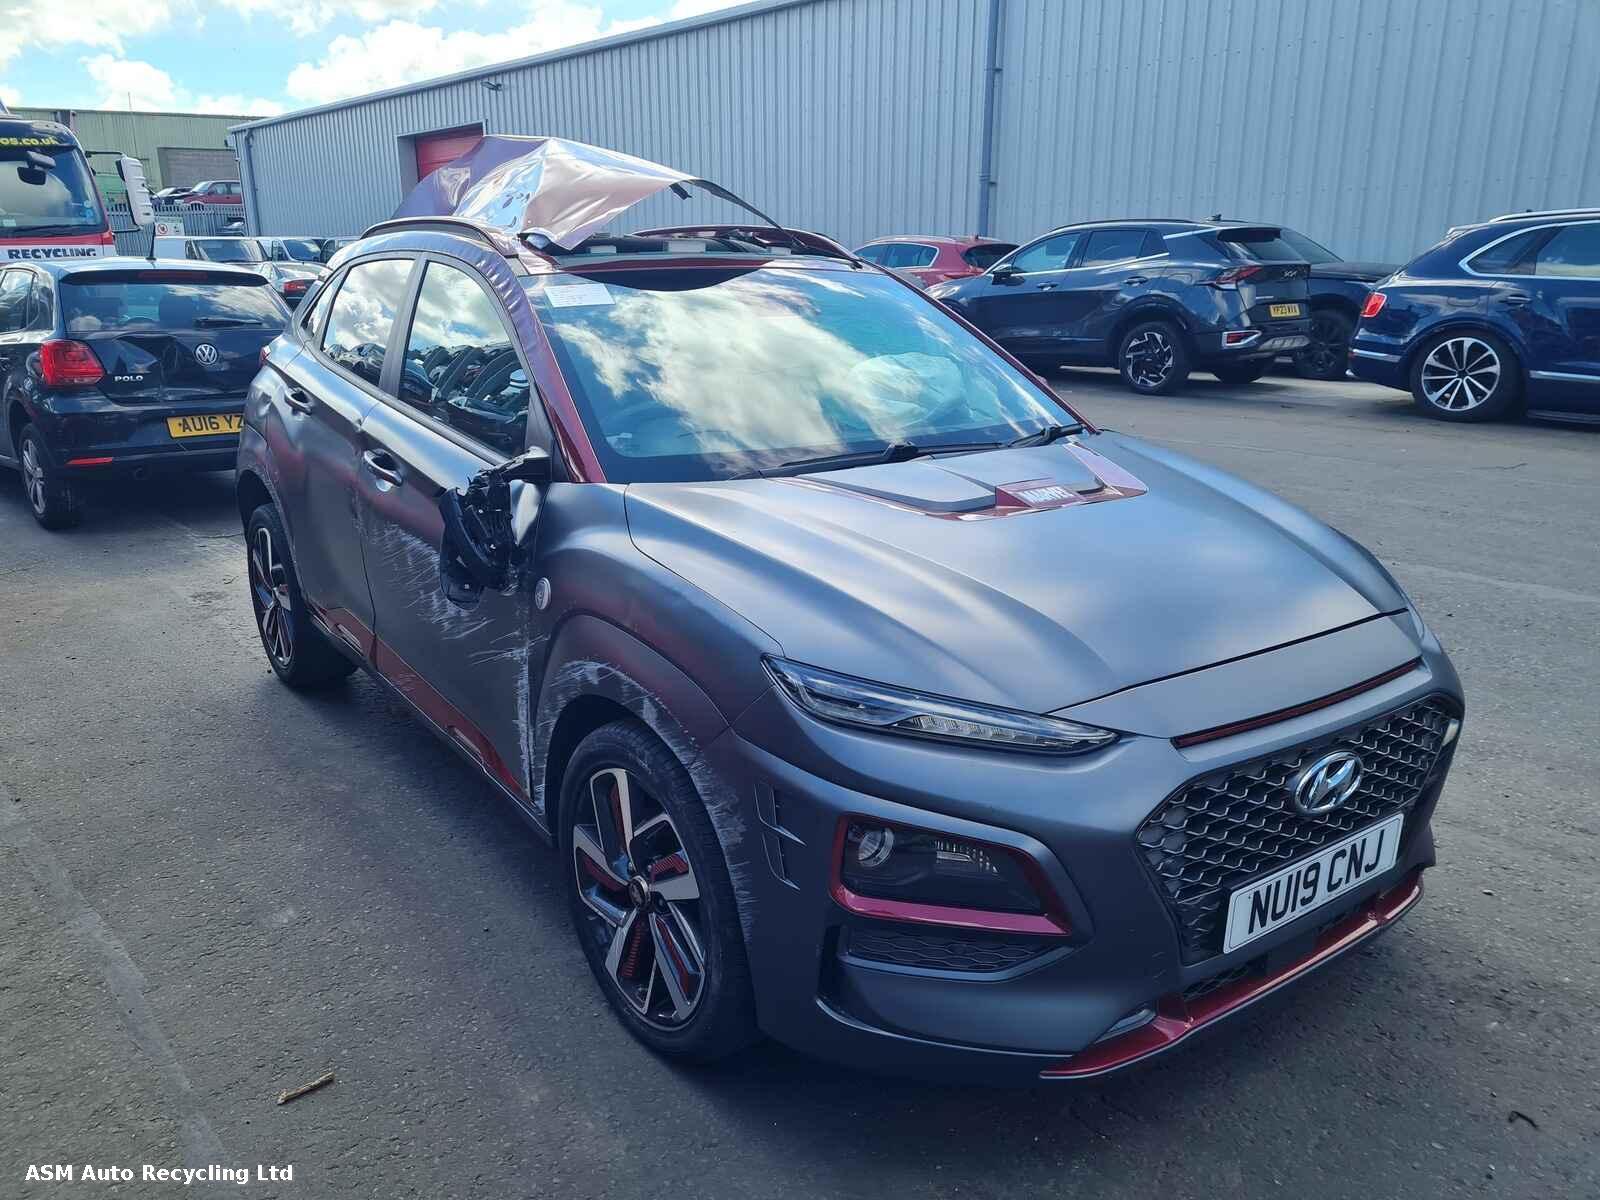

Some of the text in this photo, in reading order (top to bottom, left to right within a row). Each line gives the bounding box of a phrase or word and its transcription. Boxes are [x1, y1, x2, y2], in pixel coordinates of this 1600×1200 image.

[8, 248, 97, 259] RECYCLING
[181, 415, 220, 433] AU16
[1248, 829, 1385, 935] NU19 CNJ
